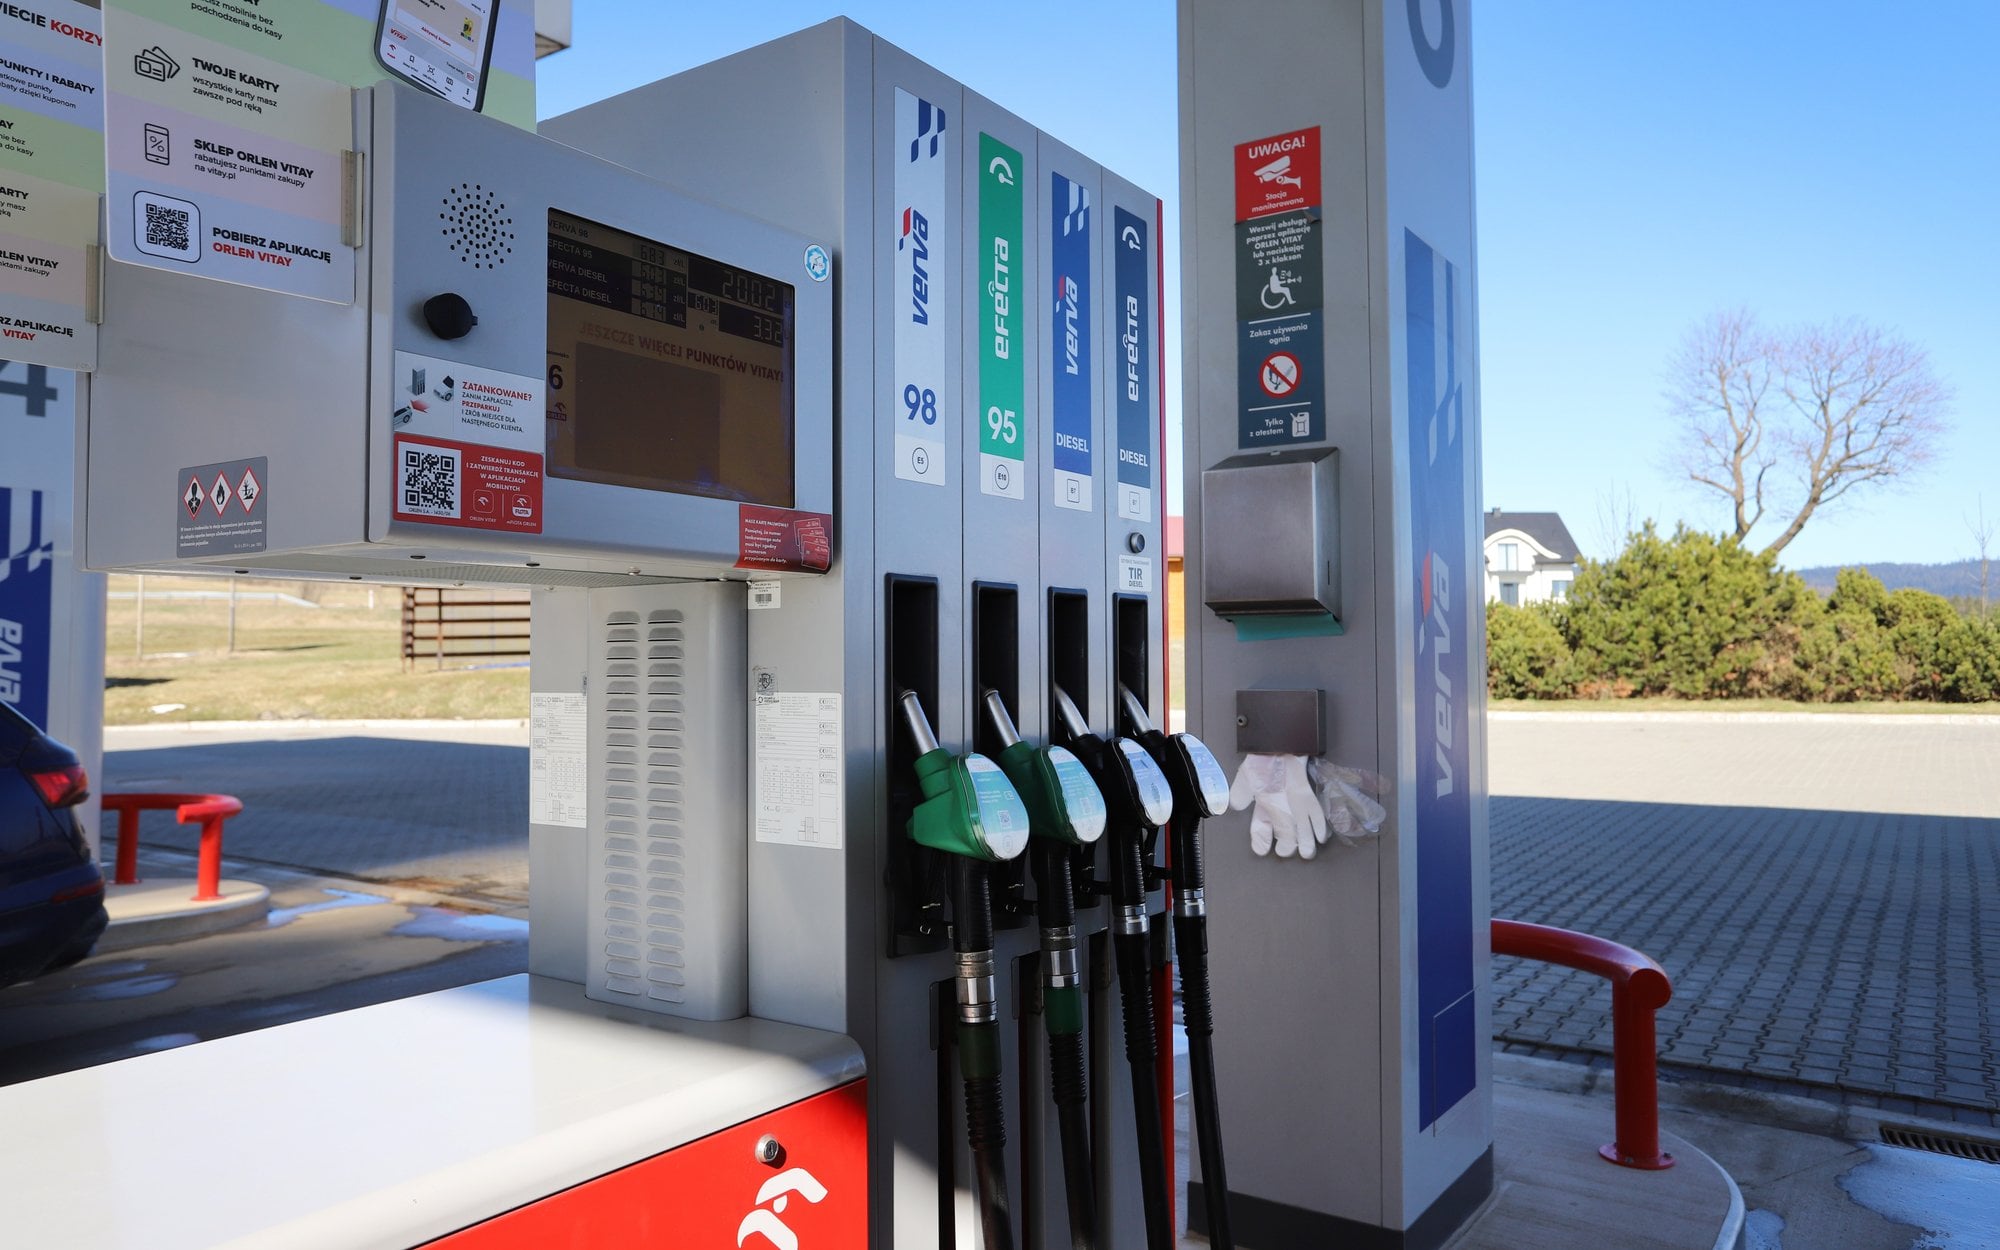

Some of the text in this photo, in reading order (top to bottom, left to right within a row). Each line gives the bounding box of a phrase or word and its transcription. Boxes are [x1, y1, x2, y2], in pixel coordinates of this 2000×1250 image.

[191, 2, 250, 28] podchodzenia
[251, 23, 263, 32] do
[264, 27, 283, 41] kasy
[222, 3, 257, 20] mobilnie
[258, 14, 274, 26] bez
[45, 72, 50, 81] I
[51, 74, 95, 94] RABATY
[192, 57, 280, 94] TWOJE KARTY
[27, 81, 53, 94] punkty
[192, 76, 278, 107] wszystkie karty masz
[42, 93, 77, 109] kuponom
[193, 87, 262, 114] zawsze pod ręką
[11, 136, 26, 146] bez
[1248, 135, 1306, 159] UWAGA!
[16, 146, 34, 157] kasy
[194, 139, 314, 179] SKLEP ORLEN VITAY
[194, 153, 305, 188] rabatujesz punktami zakupy
[194, 164, 236, 181] na vitay.pl
[1265, 191, 1287, 202] Stacja
[6, 202, 26, 212] masz
[1252, 197, 1304, 213] monitorowana
[1249, 217, 1307, 235] Wezwij obsługę
[1246, 225, 1311, 245] poprzez aplikację
[1254, 235, 1303, 250] ORLEN VITAY
[213, 227, 331, 264] POBIERZ APLIKACJĘ
[1253, 244, 1305, 259] lub naciskając
[27, 254, 59, 270] VITAY
[213, 242, 293, 267] ORLEN VITAY
[1272, 253, 1302, 264] klakson
[24, 264, 50, 277] zakupy
[578, 267, 609, 284] DIESEL
[912, 208, 929, 327] verva
[582, 287, 614, 304] DIESEL
[14, 319, 74, 338] APLIKACJĘ
[1065, 275, 1079, 376] verva
[1249, 323, 1309, 338] Zakaz używania
[3, 328, 36, 341] VITAY
[1269, 335, 1290, 345] ognia
[579, 322, 636, 347] JESZCZE
[638, 336, 683, 358] WIĘCEJ
[686, 347, 748, 375] PUNKTÓW
[548, 364, 563, 390] 6
[462, 381, 533, 402] ZATANKOWANE?
[462, 391, 482, 401] ZANIM
[461, 400, 501, 413] PRZEPARKUJ
[903, 383, 937, 426] 98
[461, 417, 501, 431] NASTĘPNEGO
[465, 409, 481, 418] ZRÓB
[482, 412, 505, 422] MIEJSCE
[505, 416, 517, 424] DLA
[1265, 418, 1284, 428] Tylko
[987, 404, 1017, 446] 95
[1255, 427, 1284, 437] atestem
[1055, 432, 1089, 455] DIESEL
[481, 456, 526, 468] ZESKANUJ KOD
[916, 456, 925, 465] E5
[1119, 448, 1148, 468] DIESEL
[488, 475, 526, 485] APLIKACJACH
[504, 467, 540, 478] TRANSAKCJĘ
[997, 472, 1007, 482] E10
[486, 482, 521, 493] MOBILNYCH
[1128, 567, 1144, 580] TIR
[1128, 580, 1144, 588] DIESEL
[1432, 551, 1454, 801] verva
